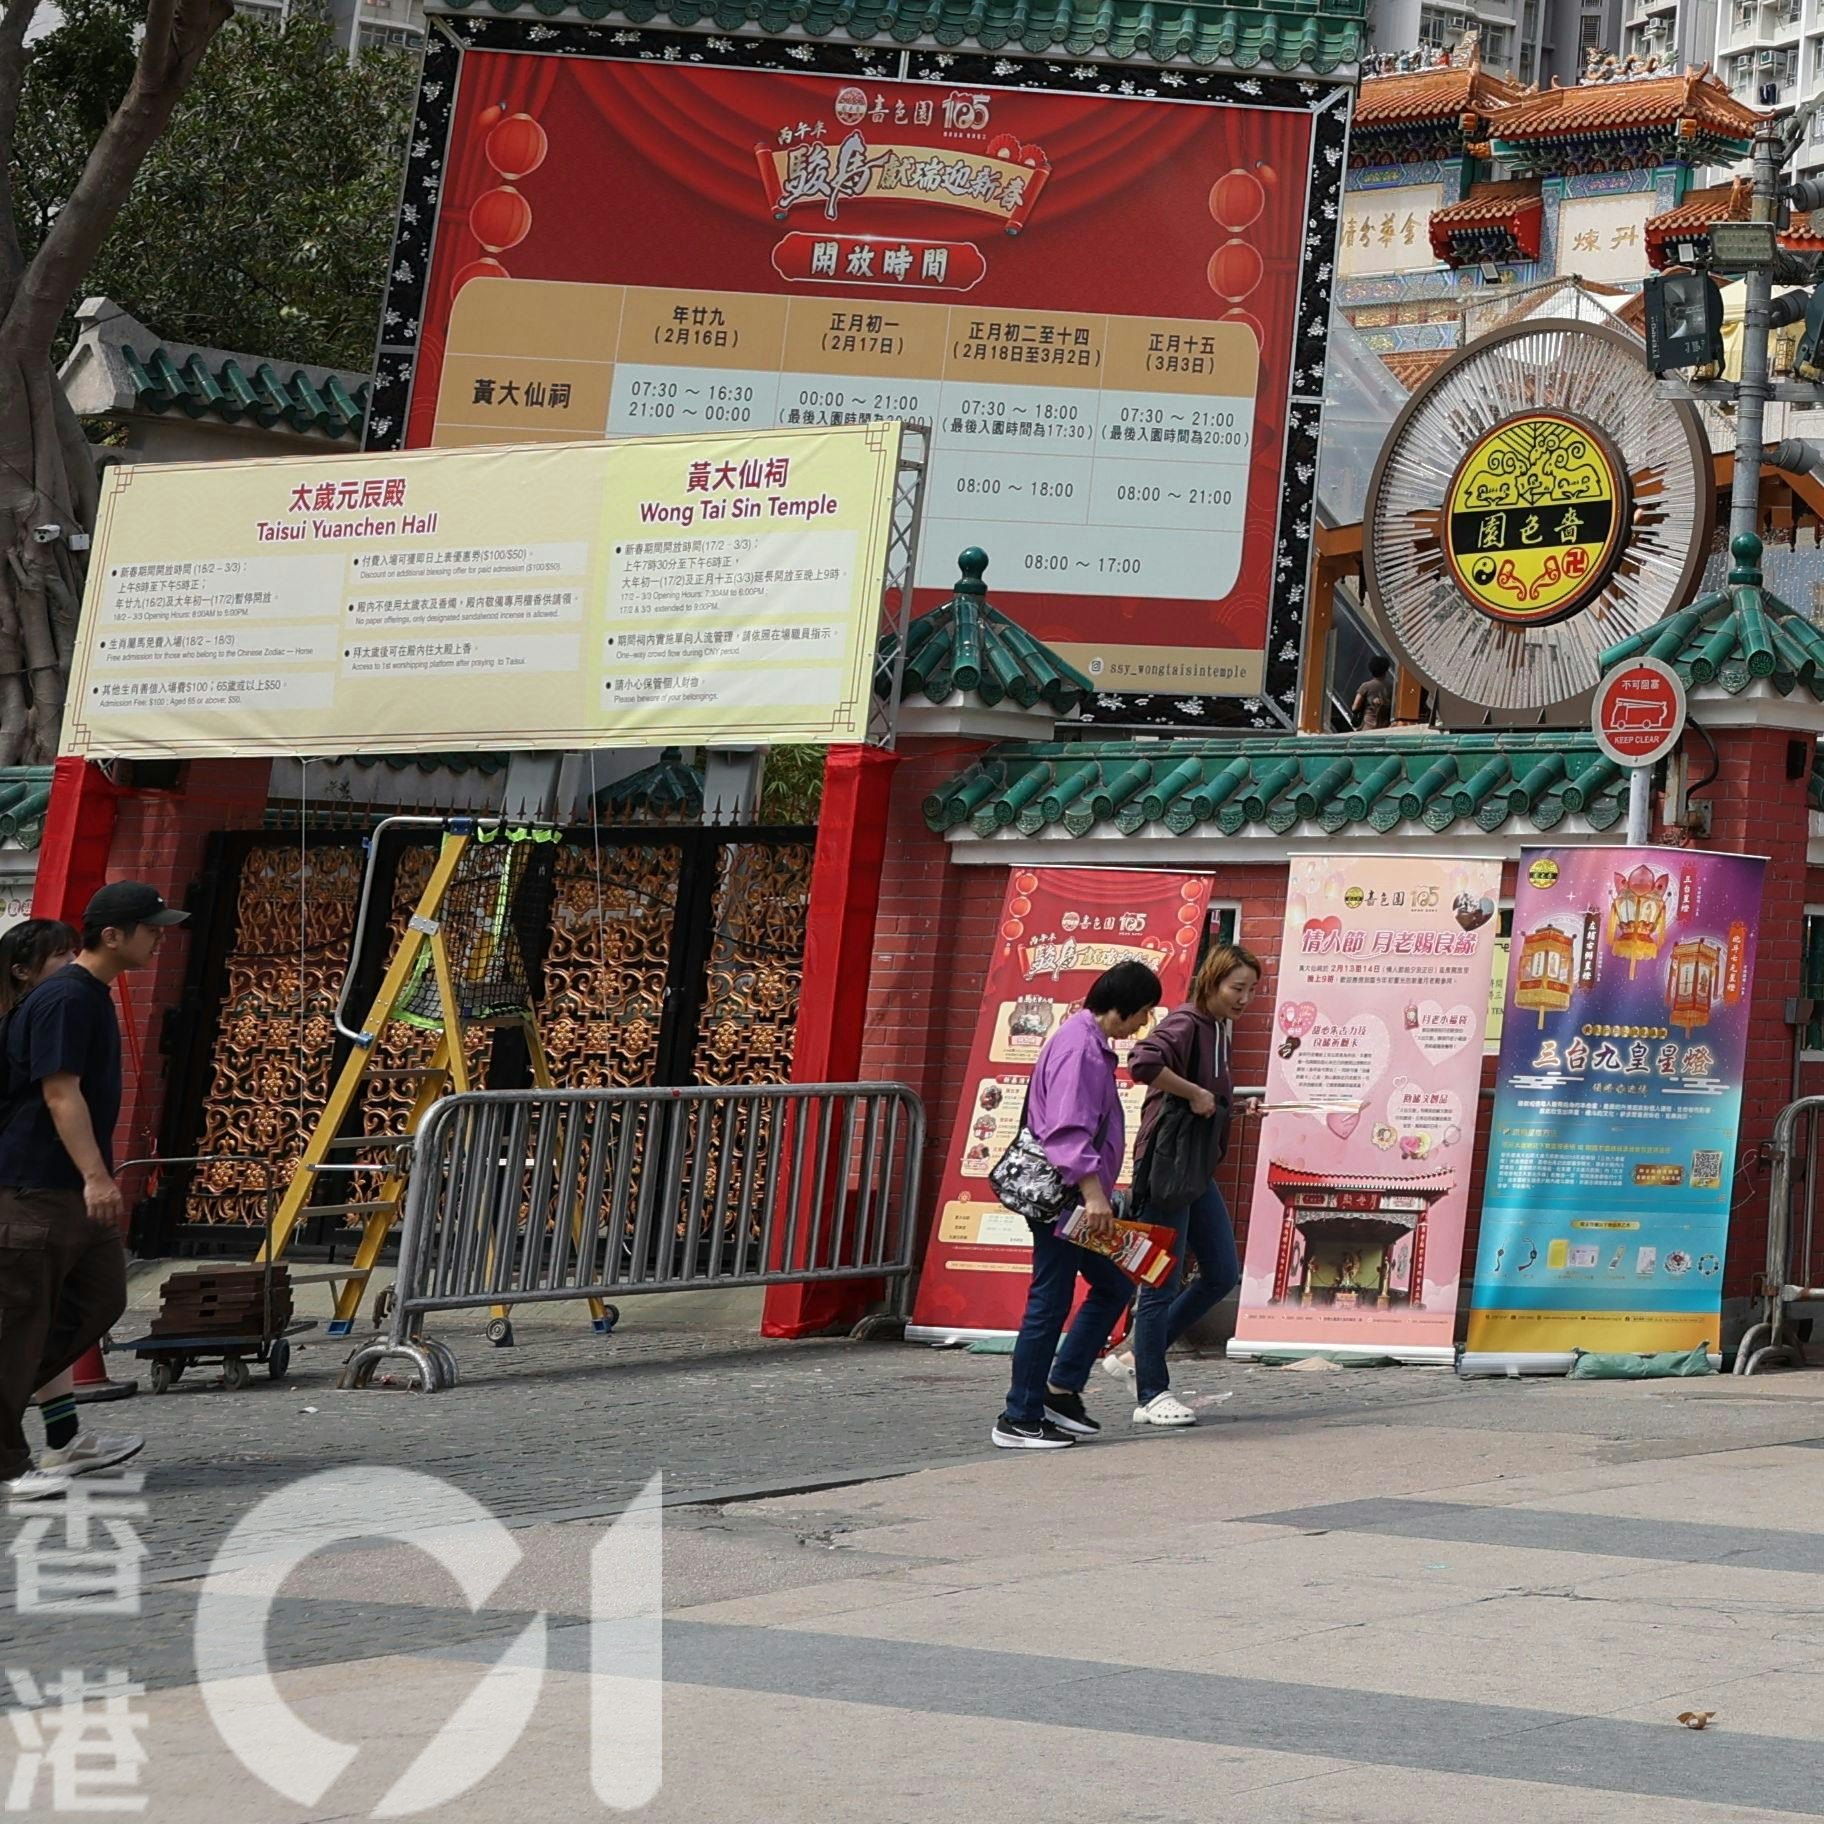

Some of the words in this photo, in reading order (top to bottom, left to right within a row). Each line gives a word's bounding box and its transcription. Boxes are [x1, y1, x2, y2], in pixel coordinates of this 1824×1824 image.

[812, 241, 949, 284] 開放時間
[673, 305, 726, 327] 年廿九
[830, 312, 900, 334] 正月初一
[968, 321, 1090, 347] 正月初二至十四
[1148, 333, 1215, 355] 正月十五
[472, 379, 572, 409] 黃大仙祠
[631, 381, 678, 398] 07:30
[709, 385, 754, 402] 16:30
[799, 390, 844, 408] 00:00
[874, 394, 918, 412] 21:00
[629, 401, 675, 419] 21:00
[705, 405, 750, 423] 00:00
[961, 399, 1006, 418] 07:30
[1035, 403, 1079, 421] 18:00
[1120, 408, 1164, 425] 07:30
[1192, 411, 1234, 428] 21:00
[687, 457, 789, 492] 黃大仙祠
[289, 478, 406, 512] 太歲元辰殿
[957, 477, 1001, 494] 08:00
[1030, 481, 1074, 499] 18:00
[1117, 485, 1161, 503] 08:00
[1189, 489, 1232, 506] 21:00
[640, 503, 694, 526] Wong
[700, 499, 726, 520] Tai
[731, 498, 761, 518] Sin
[768, 494, 838, 520] Temple
[257, 520, 306, 541] Taisui
[313, 515, 396, 539] Yuanchen
[402, 513, 437, 534] Hall
[1478, 507, 1584, 548] 嗇色園
[1024, 554, 1069, 572] 08:00
[1098, 557, 1141, 574] 17:00
[1110, 663, 1247, 680] ssy_wongtaisintemple
[1621, 679, 1660, 690] 不可阻塞
[1614, 736, 1634, 744] KEEP
[1635, 735, 1660, 744] CLEAR
[1302, 929, 1366, 954] 情人節
[1372, 931, 1477, 955] 月老賜良緣
[1532, 1038, 1714, 1075] 三台九皇星燈
